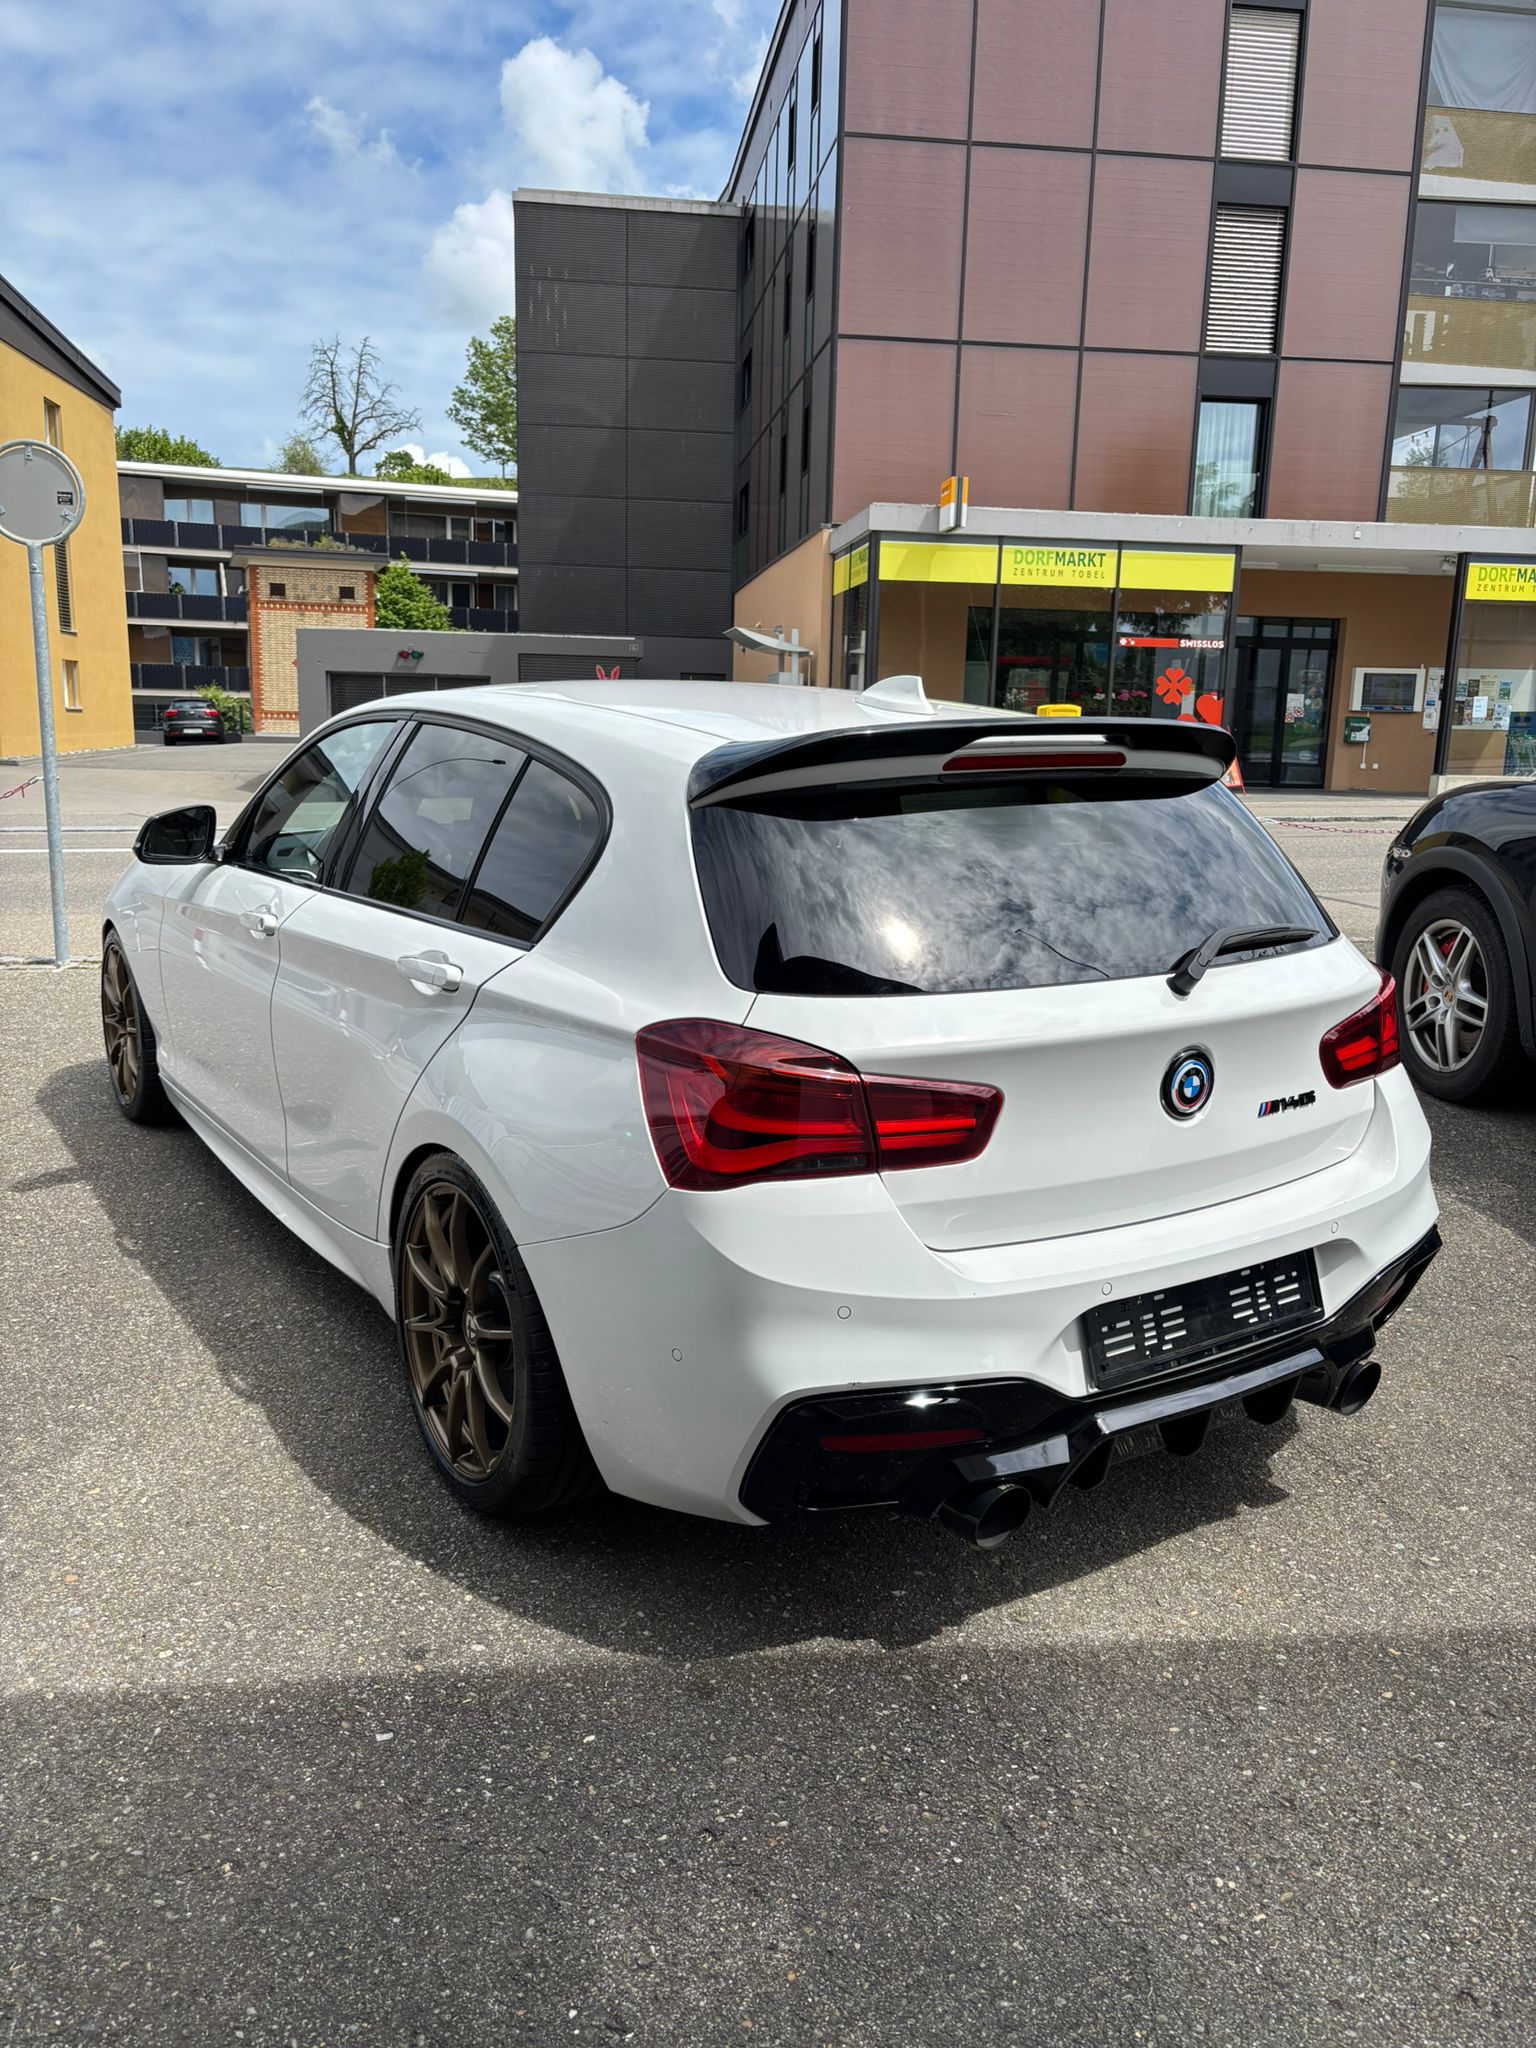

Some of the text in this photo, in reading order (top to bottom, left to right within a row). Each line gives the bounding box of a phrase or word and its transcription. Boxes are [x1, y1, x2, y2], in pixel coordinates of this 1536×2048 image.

[1013, 549, 1107, 568] DORFMARKT
[1012, 567, 1105, 579] ZENTRUM TOBEL
[1476, 583, 1525, 593] ZENTRUM
[1180, 639, 1225, 649] SWISSLOS
